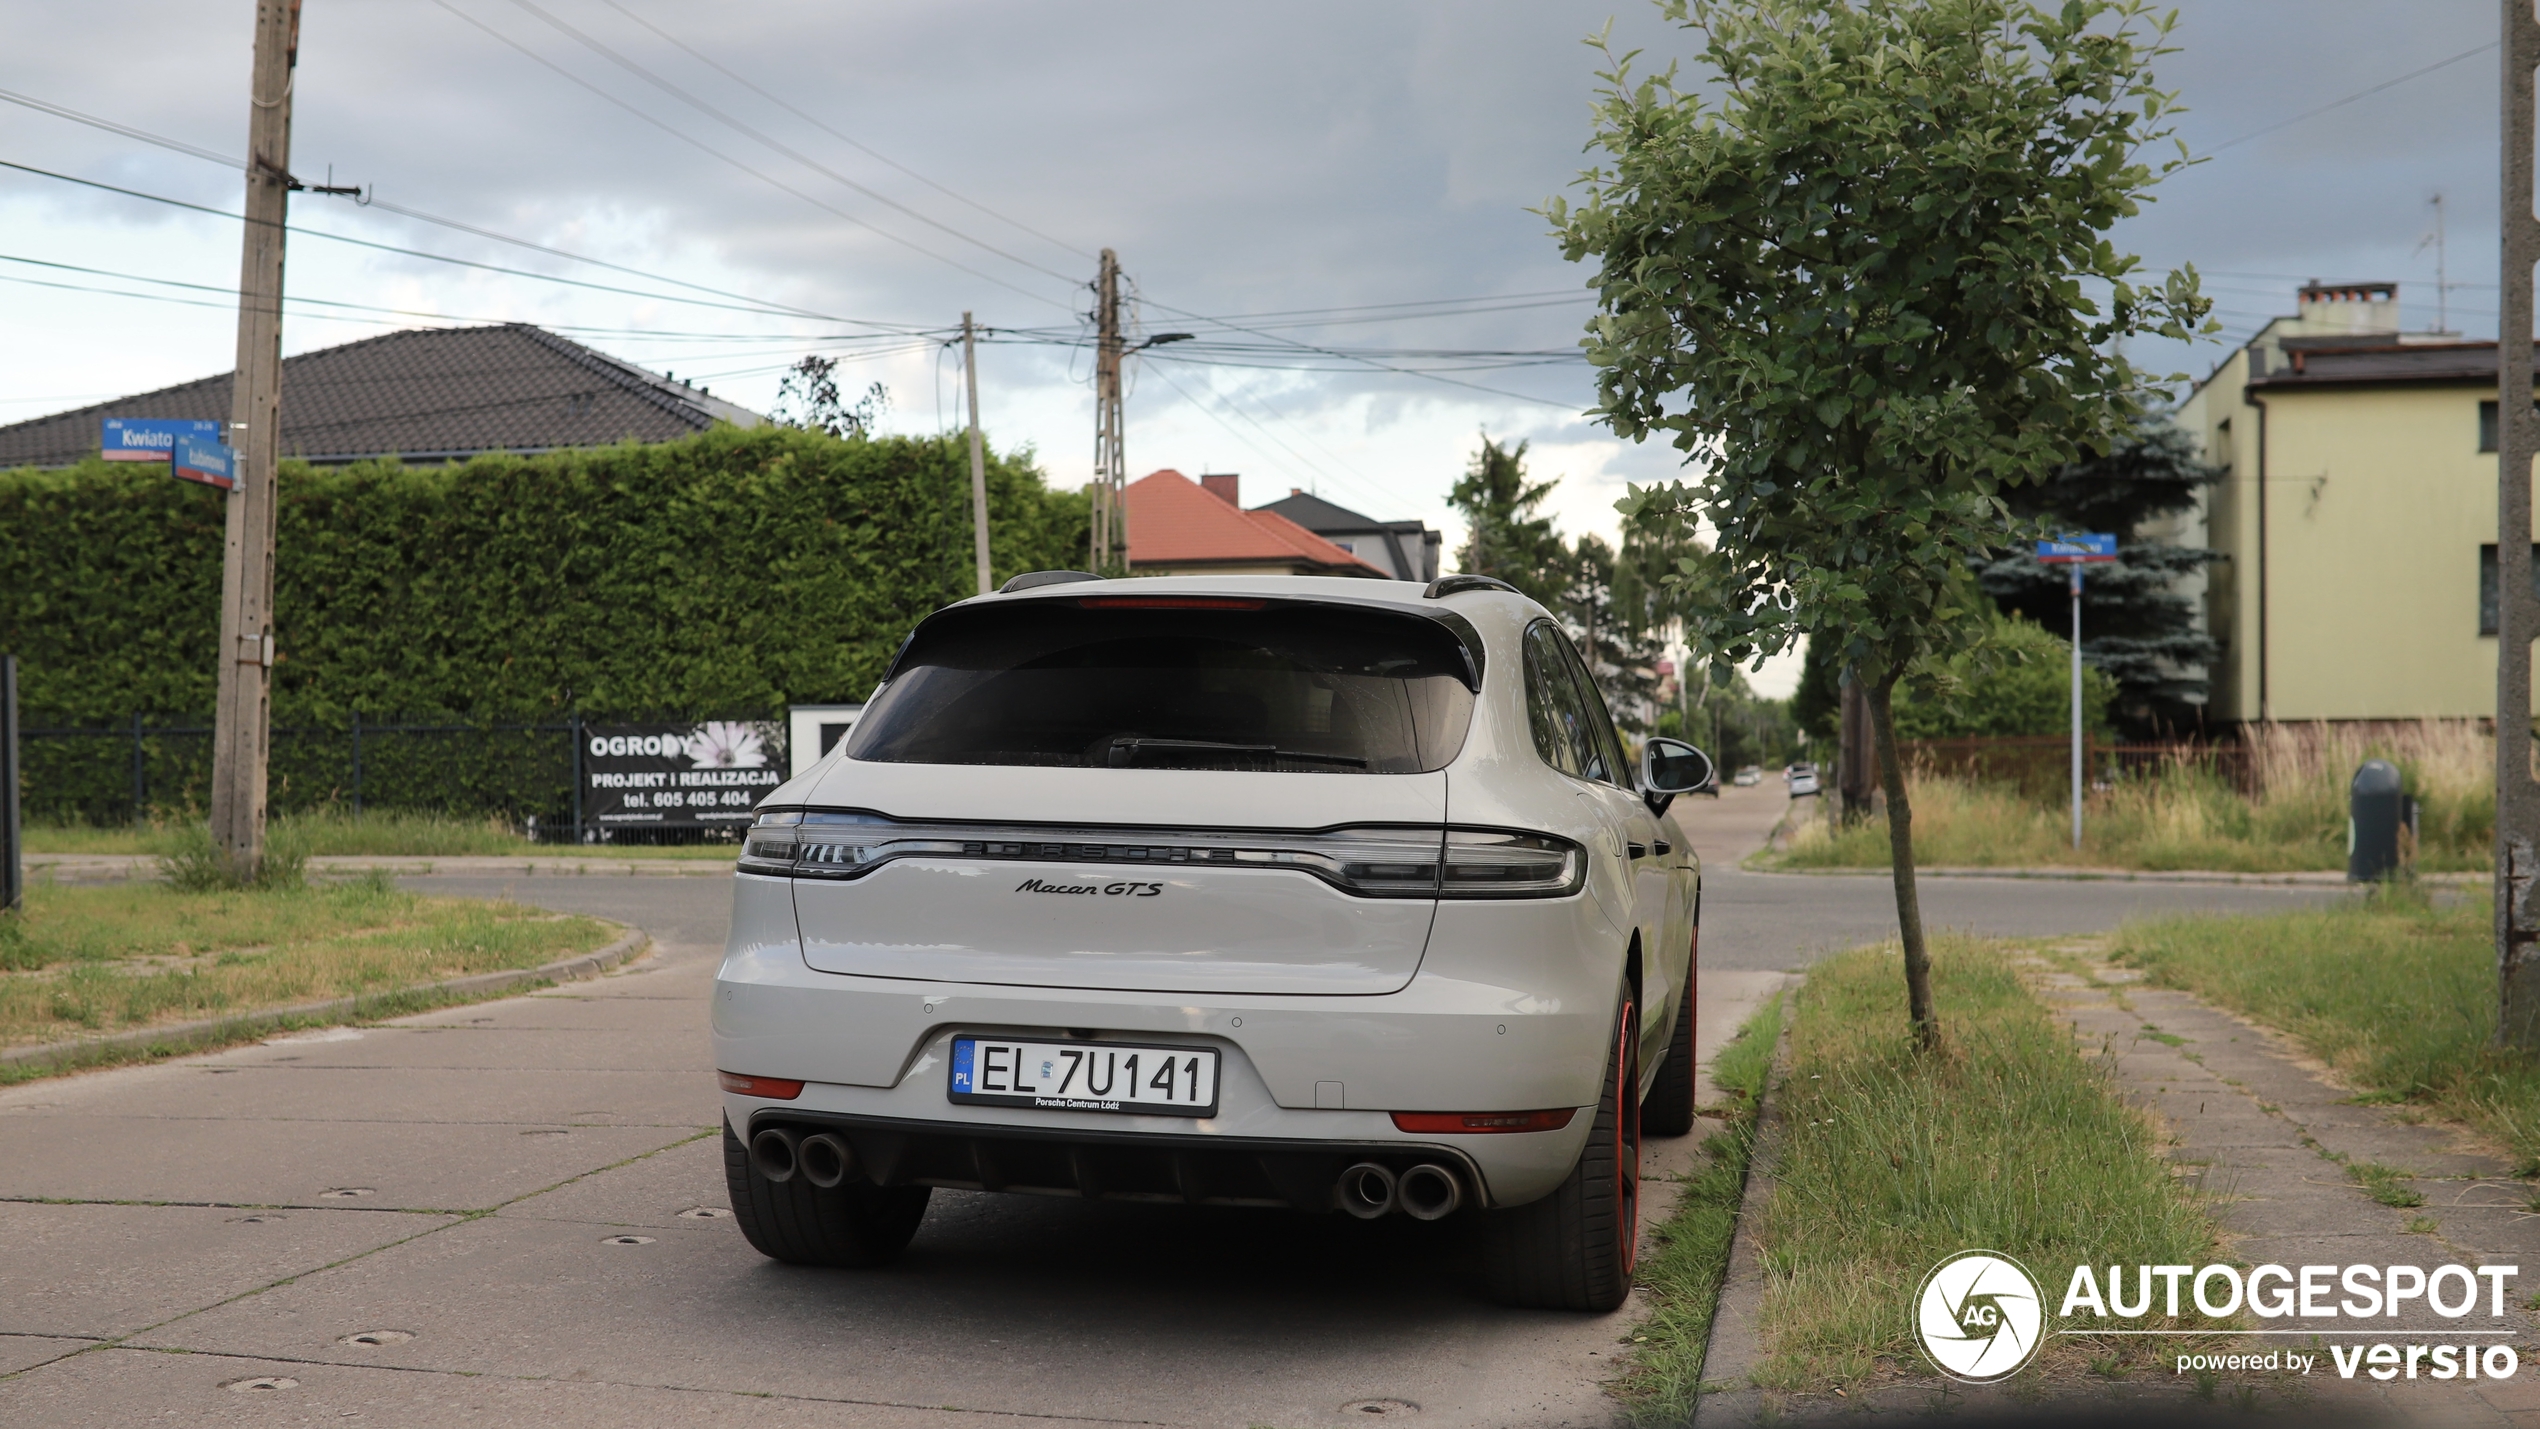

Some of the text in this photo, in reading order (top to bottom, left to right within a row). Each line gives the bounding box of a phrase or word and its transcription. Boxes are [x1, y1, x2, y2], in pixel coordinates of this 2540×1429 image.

[590, 735, 694, 757] OGRODY
[592, 772, 667, 788] PROJEKT
[680, 771, 779, 787] REALIZACJA
[623, 790, 750, 807] tel. 605 405 404
[962, 842, 1235, 862] PORSCHE
[1015, 879, 1163, 896] Macan GTS
[955, 1073, 970, 1085] PL
[982, 1046, 1199, 1101] EL 7U141
[1035, 1097, 1119, 1110] Porsche Centrum Łódź
